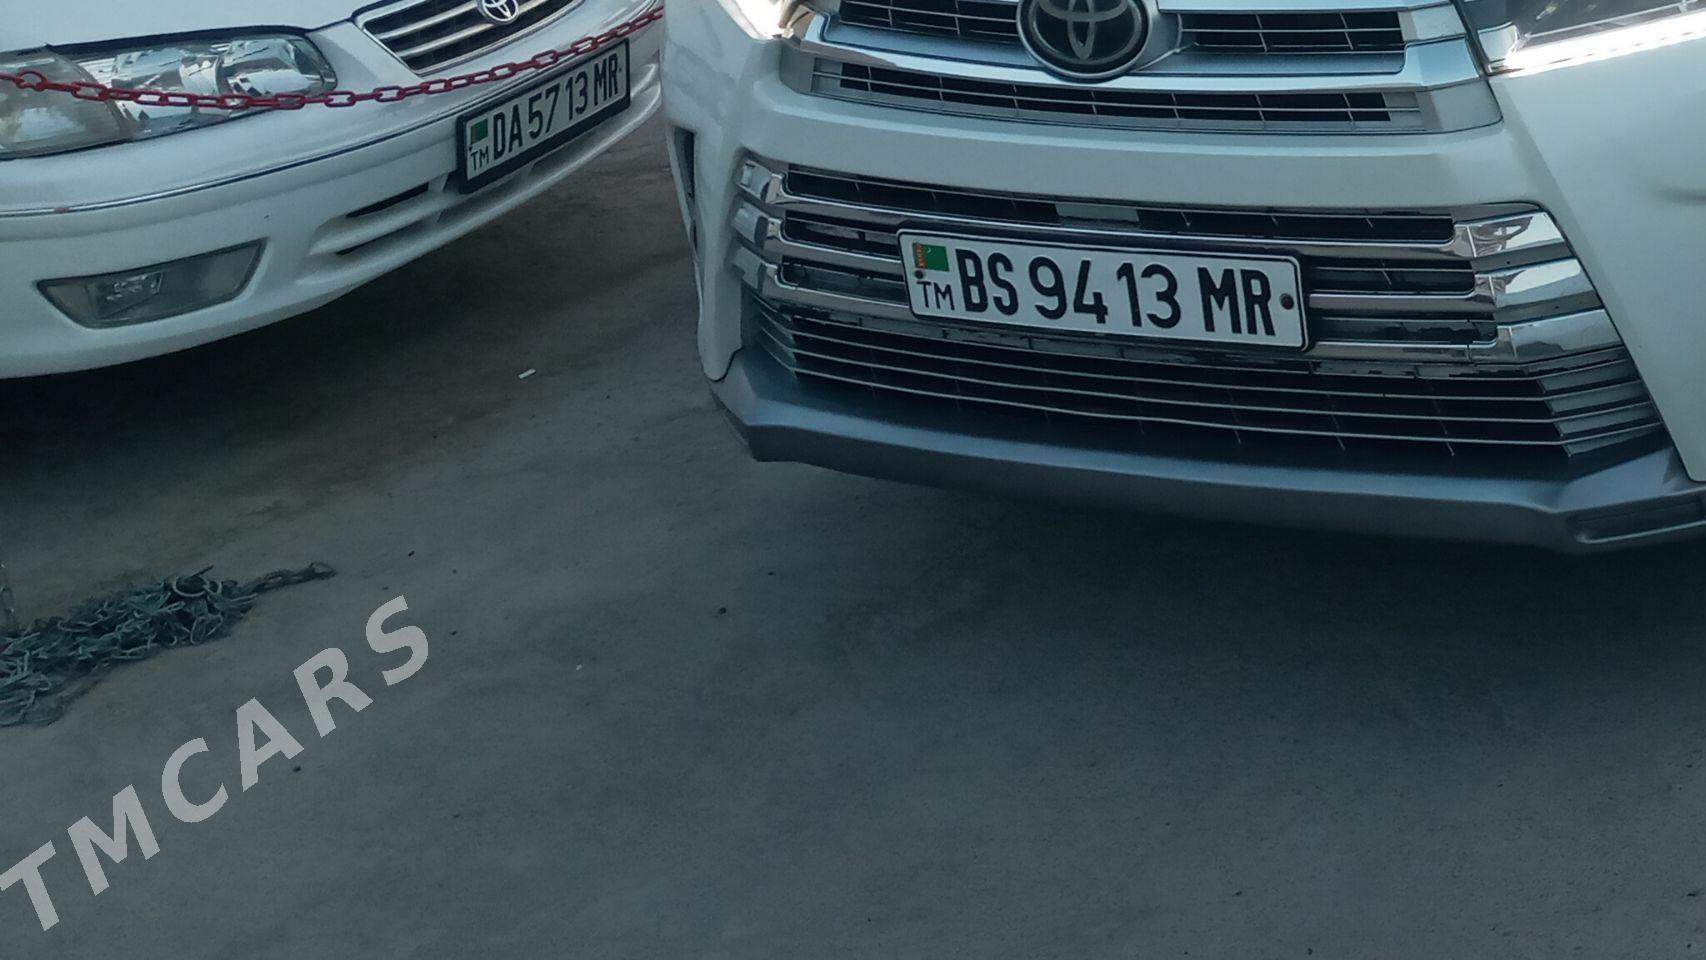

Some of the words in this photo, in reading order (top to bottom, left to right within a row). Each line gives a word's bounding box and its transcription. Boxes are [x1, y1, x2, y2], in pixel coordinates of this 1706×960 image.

[492, 104, 524, 161] DA
[593, 52, 619, 107] MR
[470, 146, 490, 171] TM
[917, 281, 955, 311] TM
[955, 248, 1020, 318] BS
[1197, 266, 1276, 337] MR
